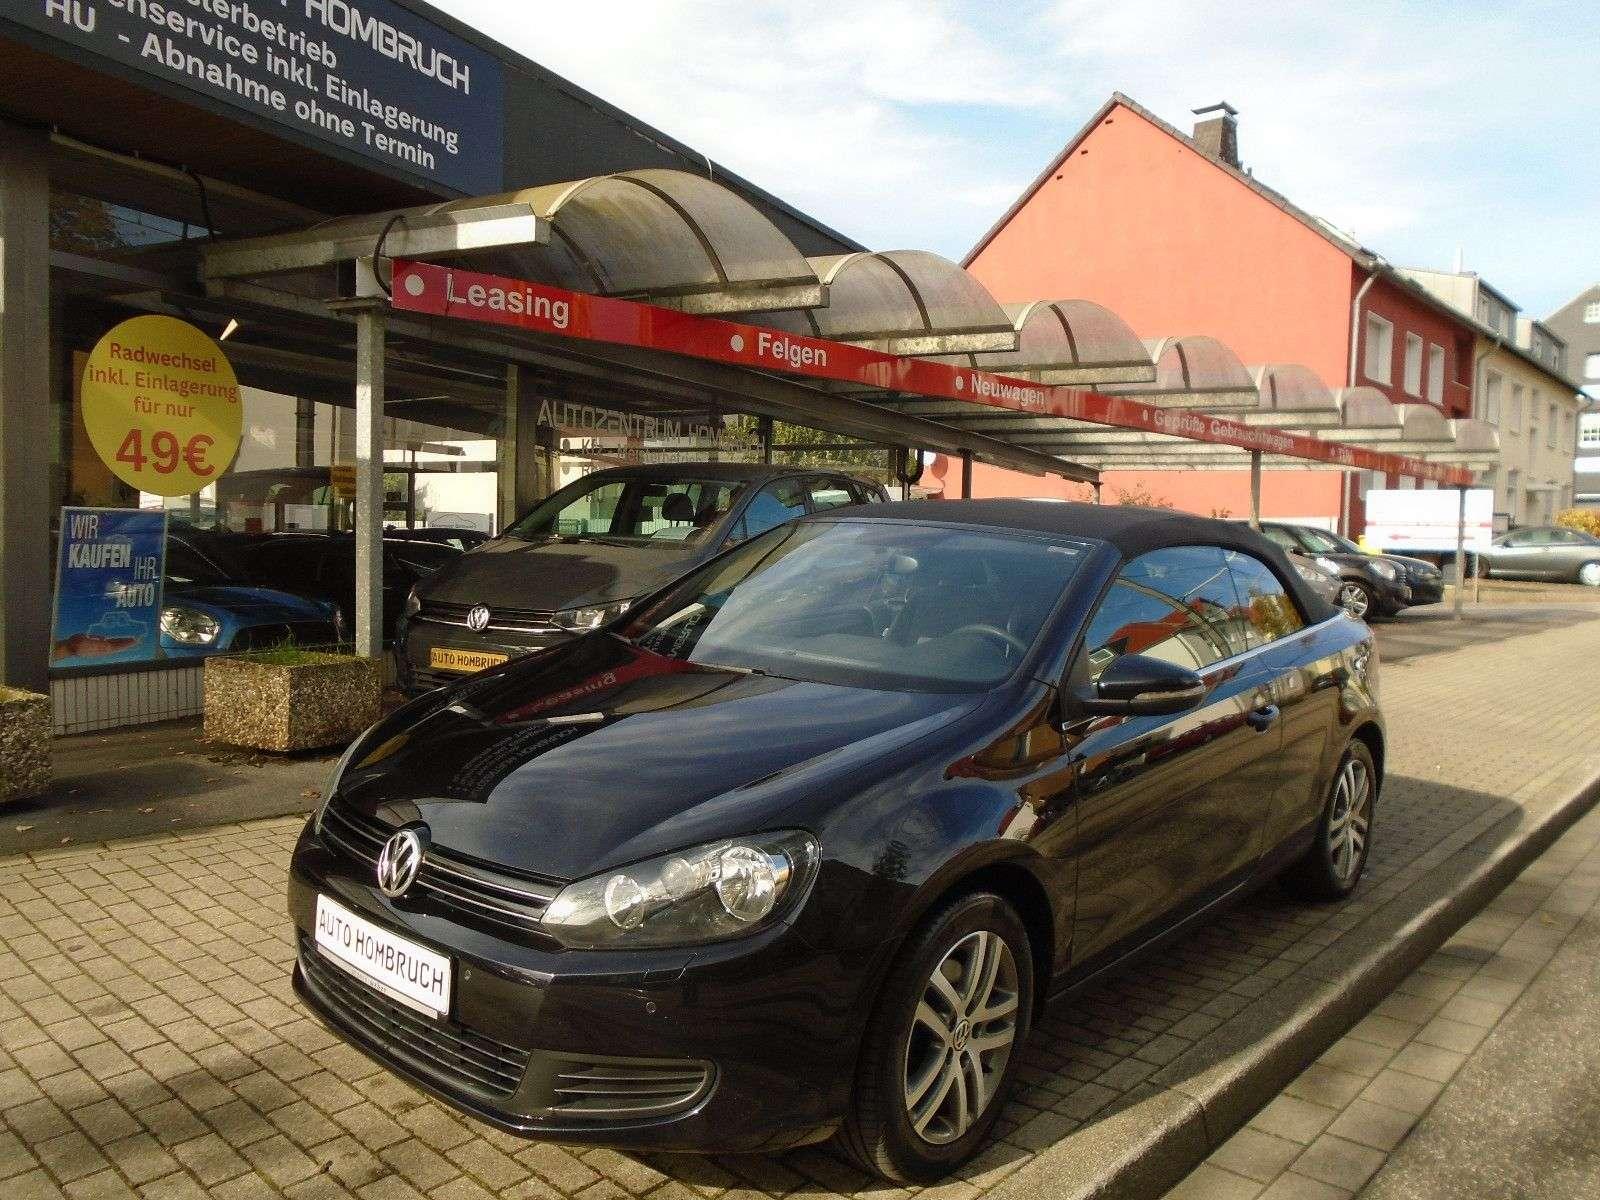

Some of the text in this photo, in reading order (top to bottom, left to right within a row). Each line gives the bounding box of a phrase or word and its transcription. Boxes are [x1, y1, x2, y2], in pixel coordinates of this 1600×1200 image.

[305, 0, 470, 95] HOMBRUCH
[45, 0, 95, 33] HU
[141, 32, 286, 110] Abnahme
[294, 100, 355, 138] ohne
[361, 121, 435, 170] Termin
[266, 46, 319, 92] inkl.
[326, 73, 459, 155] Einlagerung
[447, 273, 569, 328] Leasing
[110, 343, 217, 373] Radwechsel
[758, 332, 828, 368] Felgen
[89, 365, 237, 404] inkl. Einlagerung
[971, 373, 1045, 406] Neuwagen
[133, 395, 197, 418] für nur
[116, 428, 216, 477] 49€
[70, 514, 99, 539] WIR
[68, 543, 131, 568] KAUFEN
[134, 556, 156, 581] IHR
[433, 652, 455, 665] AUTO
[319, 909, 352, 947] AUTO
[355, 928, 444, 996] HOMBRUCH
